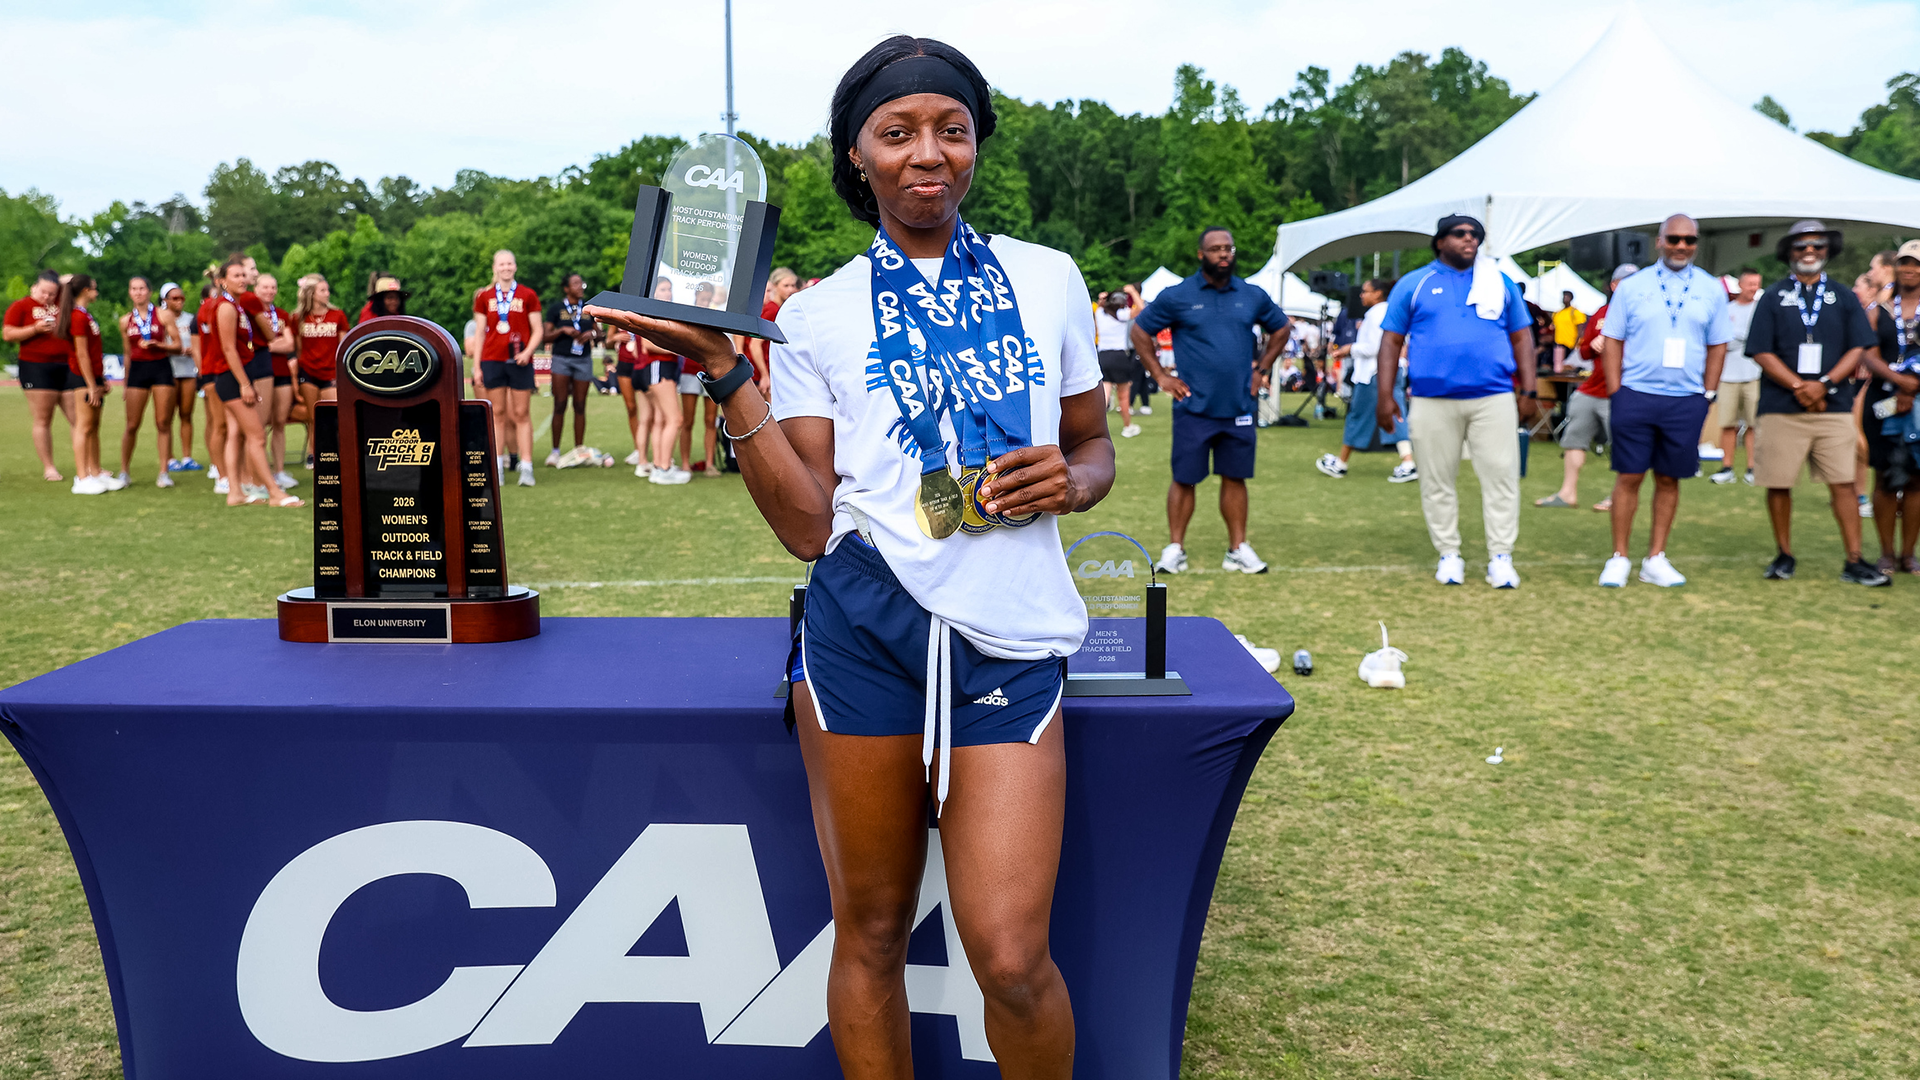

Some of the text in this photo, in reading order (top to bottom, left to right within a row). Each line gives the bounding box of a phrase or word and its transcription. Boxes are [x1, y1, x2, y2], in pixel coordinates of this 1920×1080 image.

[684, 164, 744, 193] CAA
[672, 205, 744, 222] MOST OUTSTANDING
[672, 214, 742, 233] TRACK PERFORMER
[682, 250, 718, 263] WOMEN'S
[871, 230, 904, 270] CAA
[680, 259, 717, 272] OUTDOOR
[671, 267, 695, 277] TRACK
[702, 272, 724, 283] FIELD
[685, 282, 704, 292] 2026
[983, 263, 1014, 310] CAA
[907, 281, 955, 327] CAA
[940, 279, 963, 315] AA
[877, 291, 902, 339] CAA
[355, 350, 424, 375] CAA
[1002, 335, 1025, 395] CAA
[956, 347, 1004, 401] CAA
[889, 359, 926, 421] CAA
[392, 429, 420, 439] CAA
[367, 438, 432, 456] TRACK &
[377, 454, 431, 471] FIELD
[393, 497, 415, 507] 2026
[381, 515, 428, 525] WOMEN'S
[382, 533, 430, 543] OUTDOOR
[371, 551, 443, 561] TRACK & FIELD
[379, 568, 436, 578] CHAMPIONS
[1077, 560, 1135, 578] CAA
[353, 619, 426, 627] ELON UNIVERSITY
